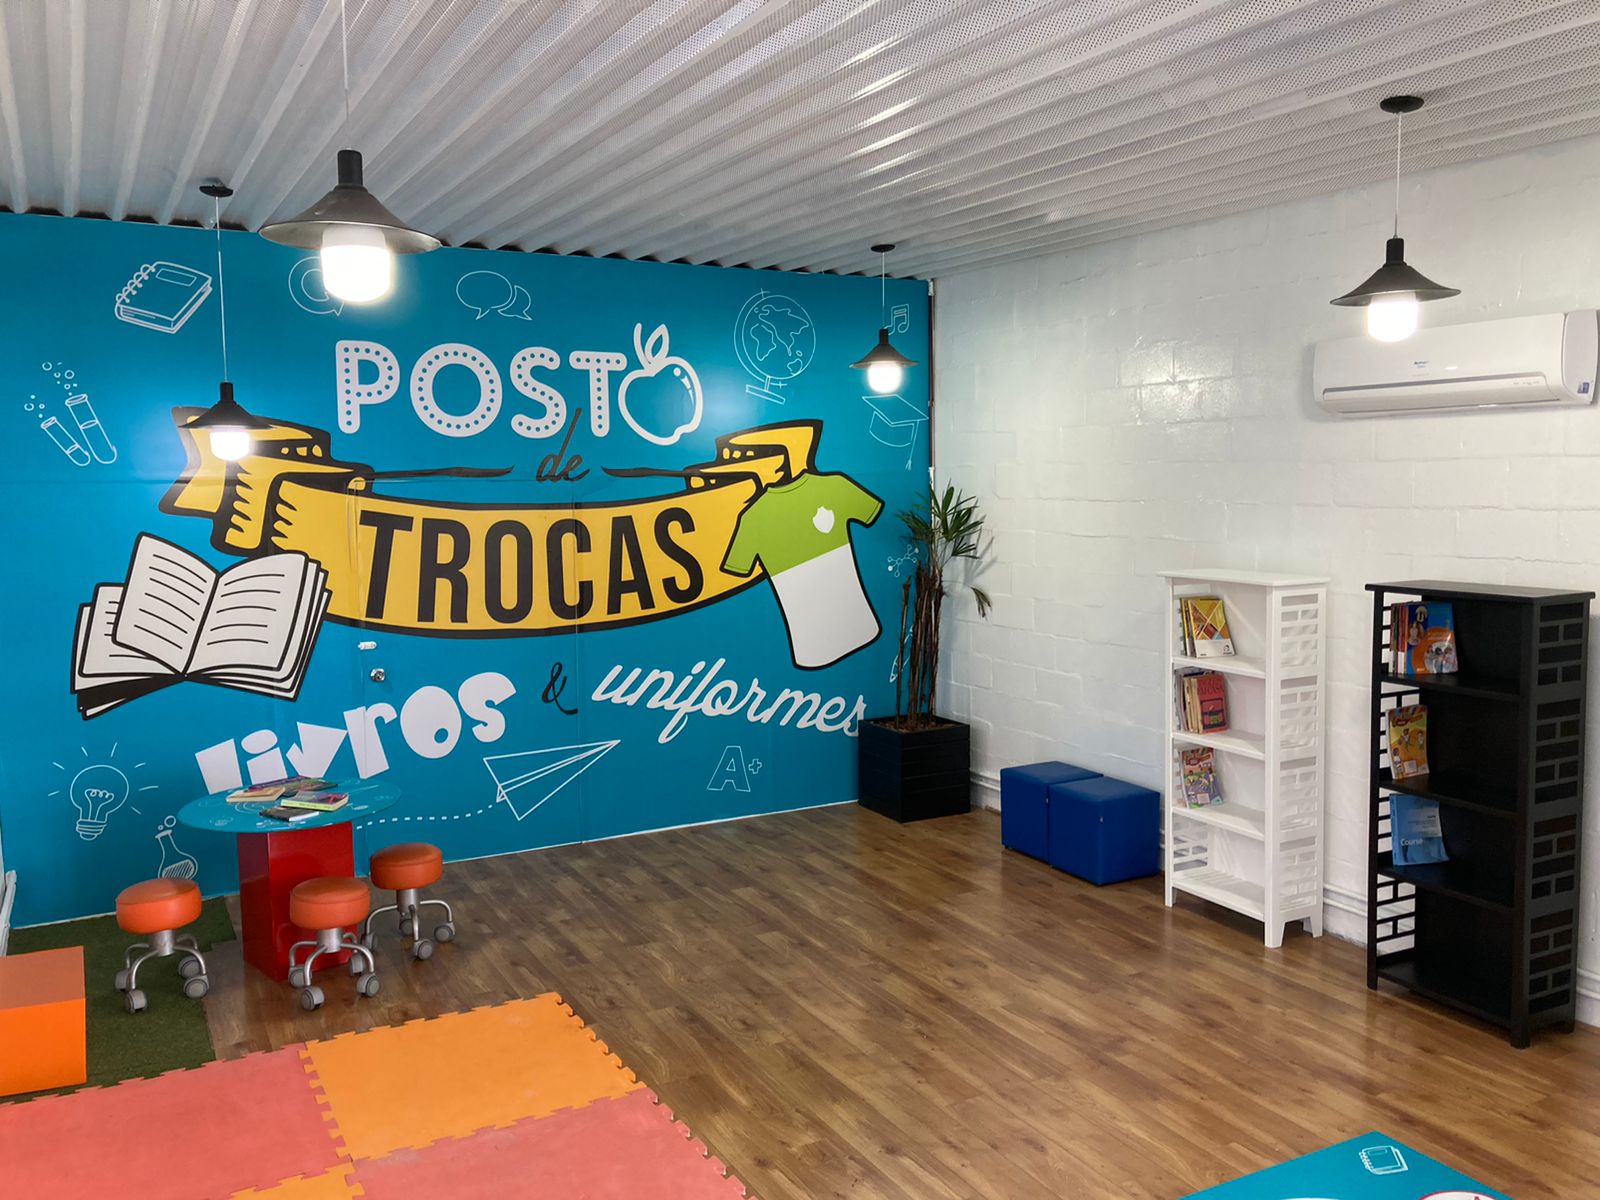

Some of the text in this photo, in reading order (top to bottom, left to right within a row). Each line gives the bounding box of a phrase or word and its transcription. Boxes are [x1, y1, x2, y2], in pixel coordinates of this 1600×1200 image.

[535, 407, 590, 482] de
[359, 507, 704, 624] TROCAS
[194, 657, 867, 795] livros & uniformes
